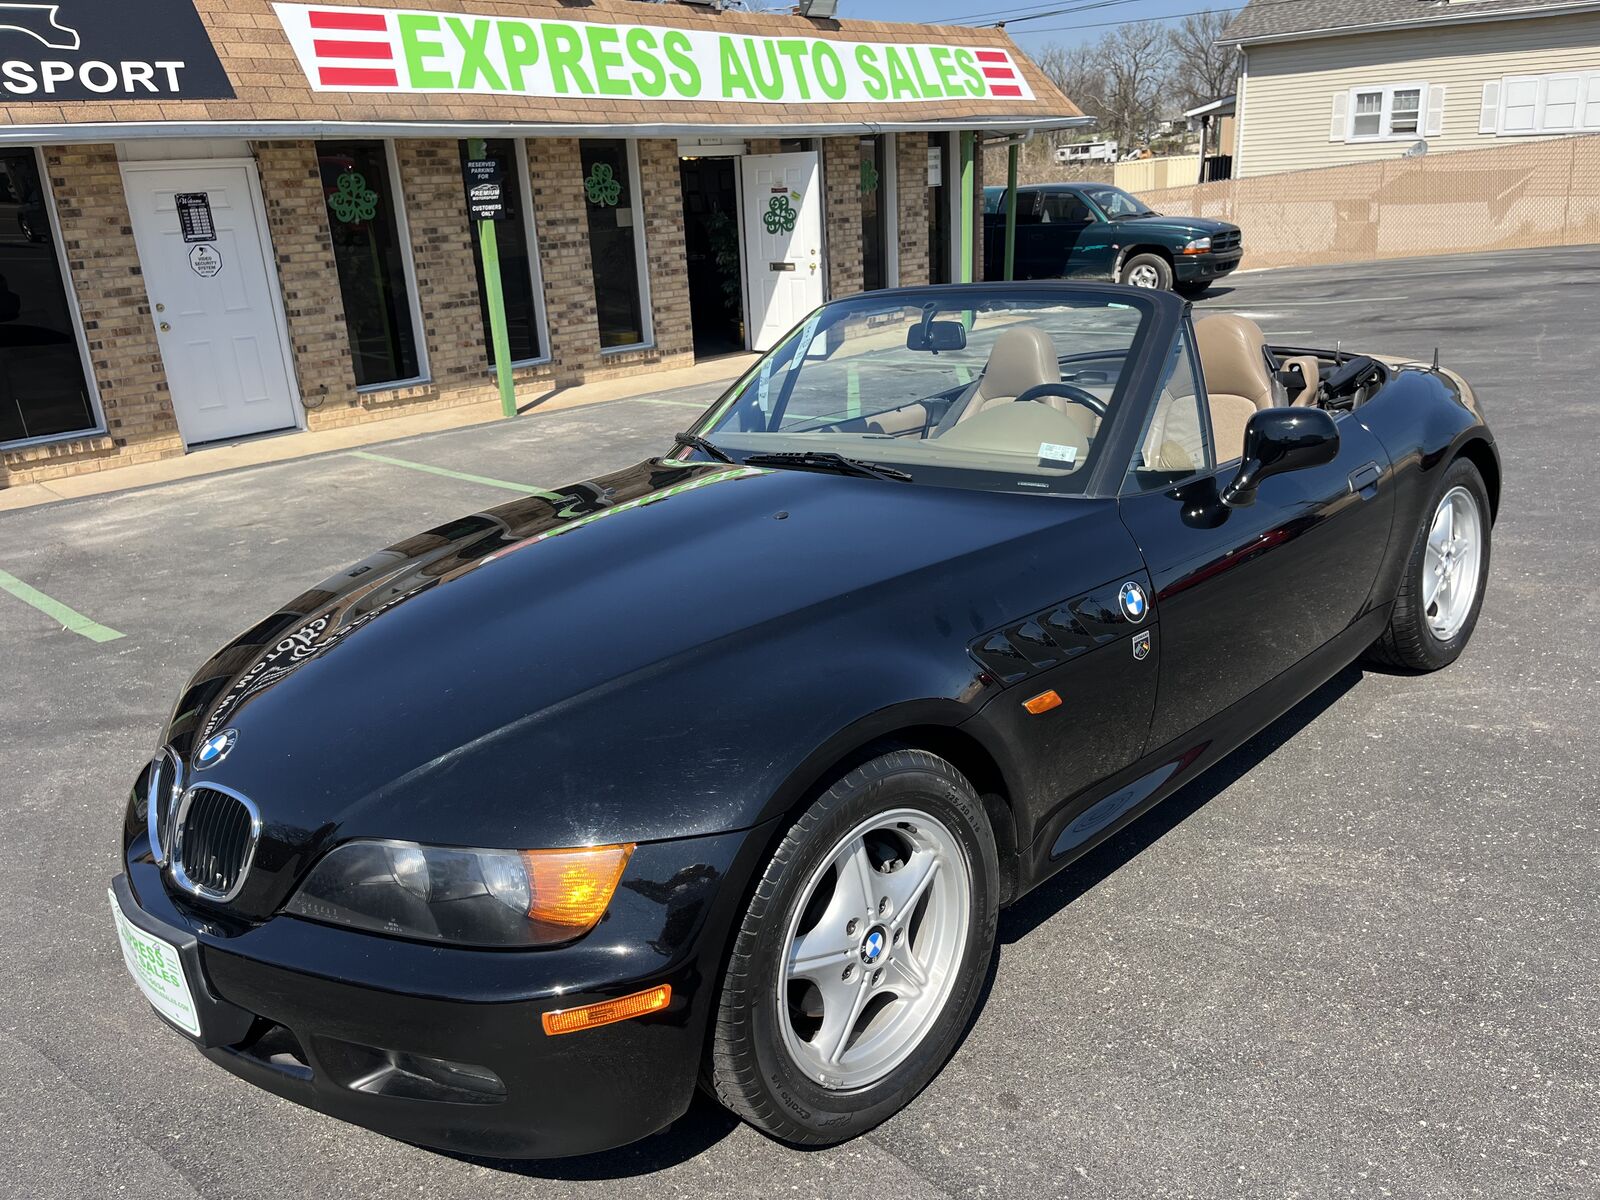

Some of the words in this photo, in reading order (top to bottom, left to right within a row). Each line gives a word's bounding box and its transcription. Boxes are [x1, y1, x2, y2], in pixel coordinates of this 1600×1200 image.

[397, 14, 702, 98] EXPRESS
[719, 36, 847, 101] AUTO
[855, 45, 986, 100] SALES
[1, 60, 185, 95] SPORT
[139, 957, 180, 988] SALES
